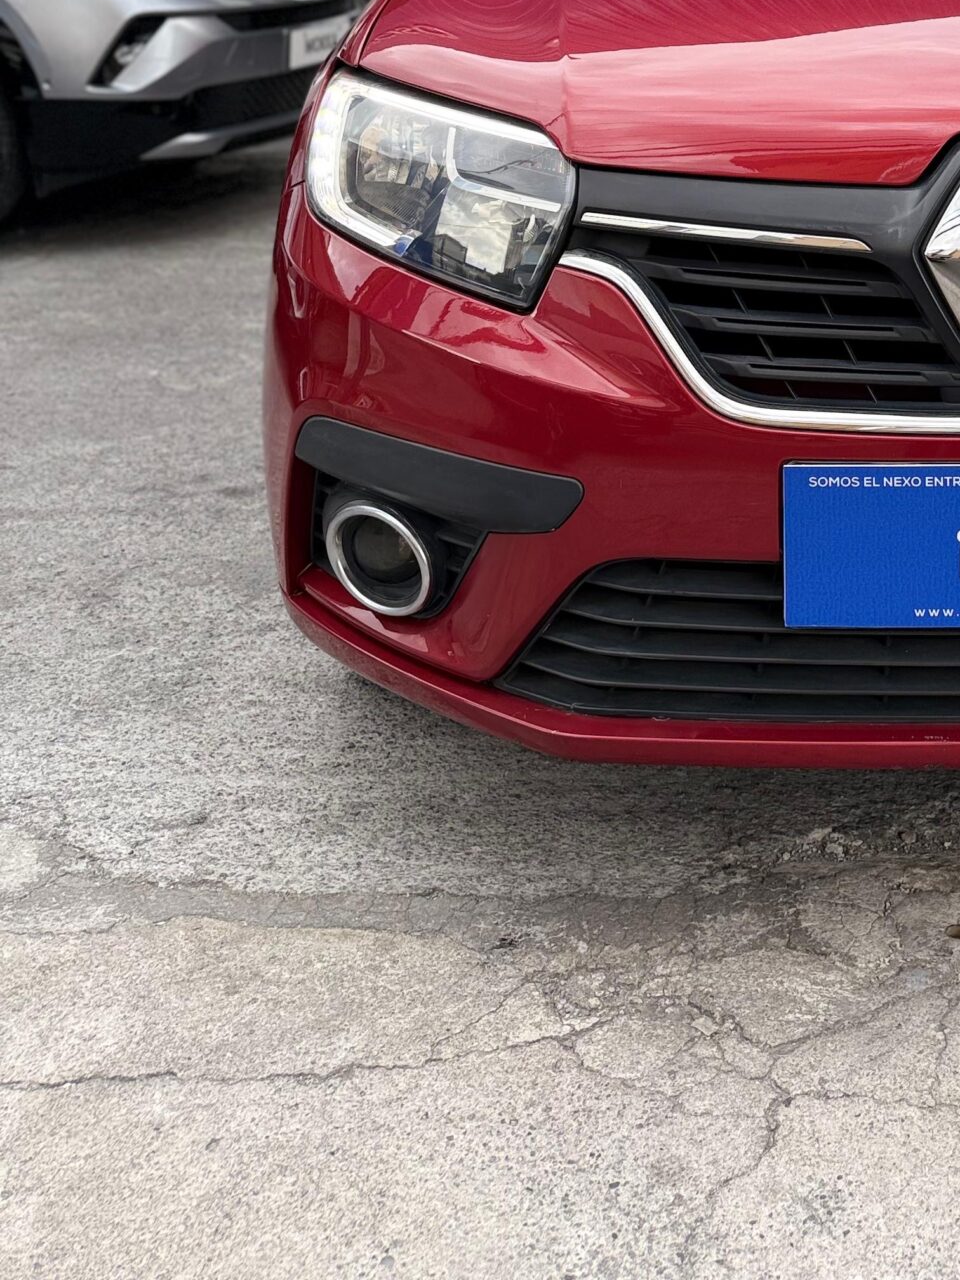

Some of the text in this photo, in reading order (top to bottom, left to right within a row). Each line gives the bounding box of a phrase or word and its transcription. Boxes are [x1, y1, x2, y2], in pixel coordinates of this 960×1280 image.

[808, 476, 860, 487] SOMOS
[863, 476, 880, 487] EL
[883, 476, 922, 487] NEXO
